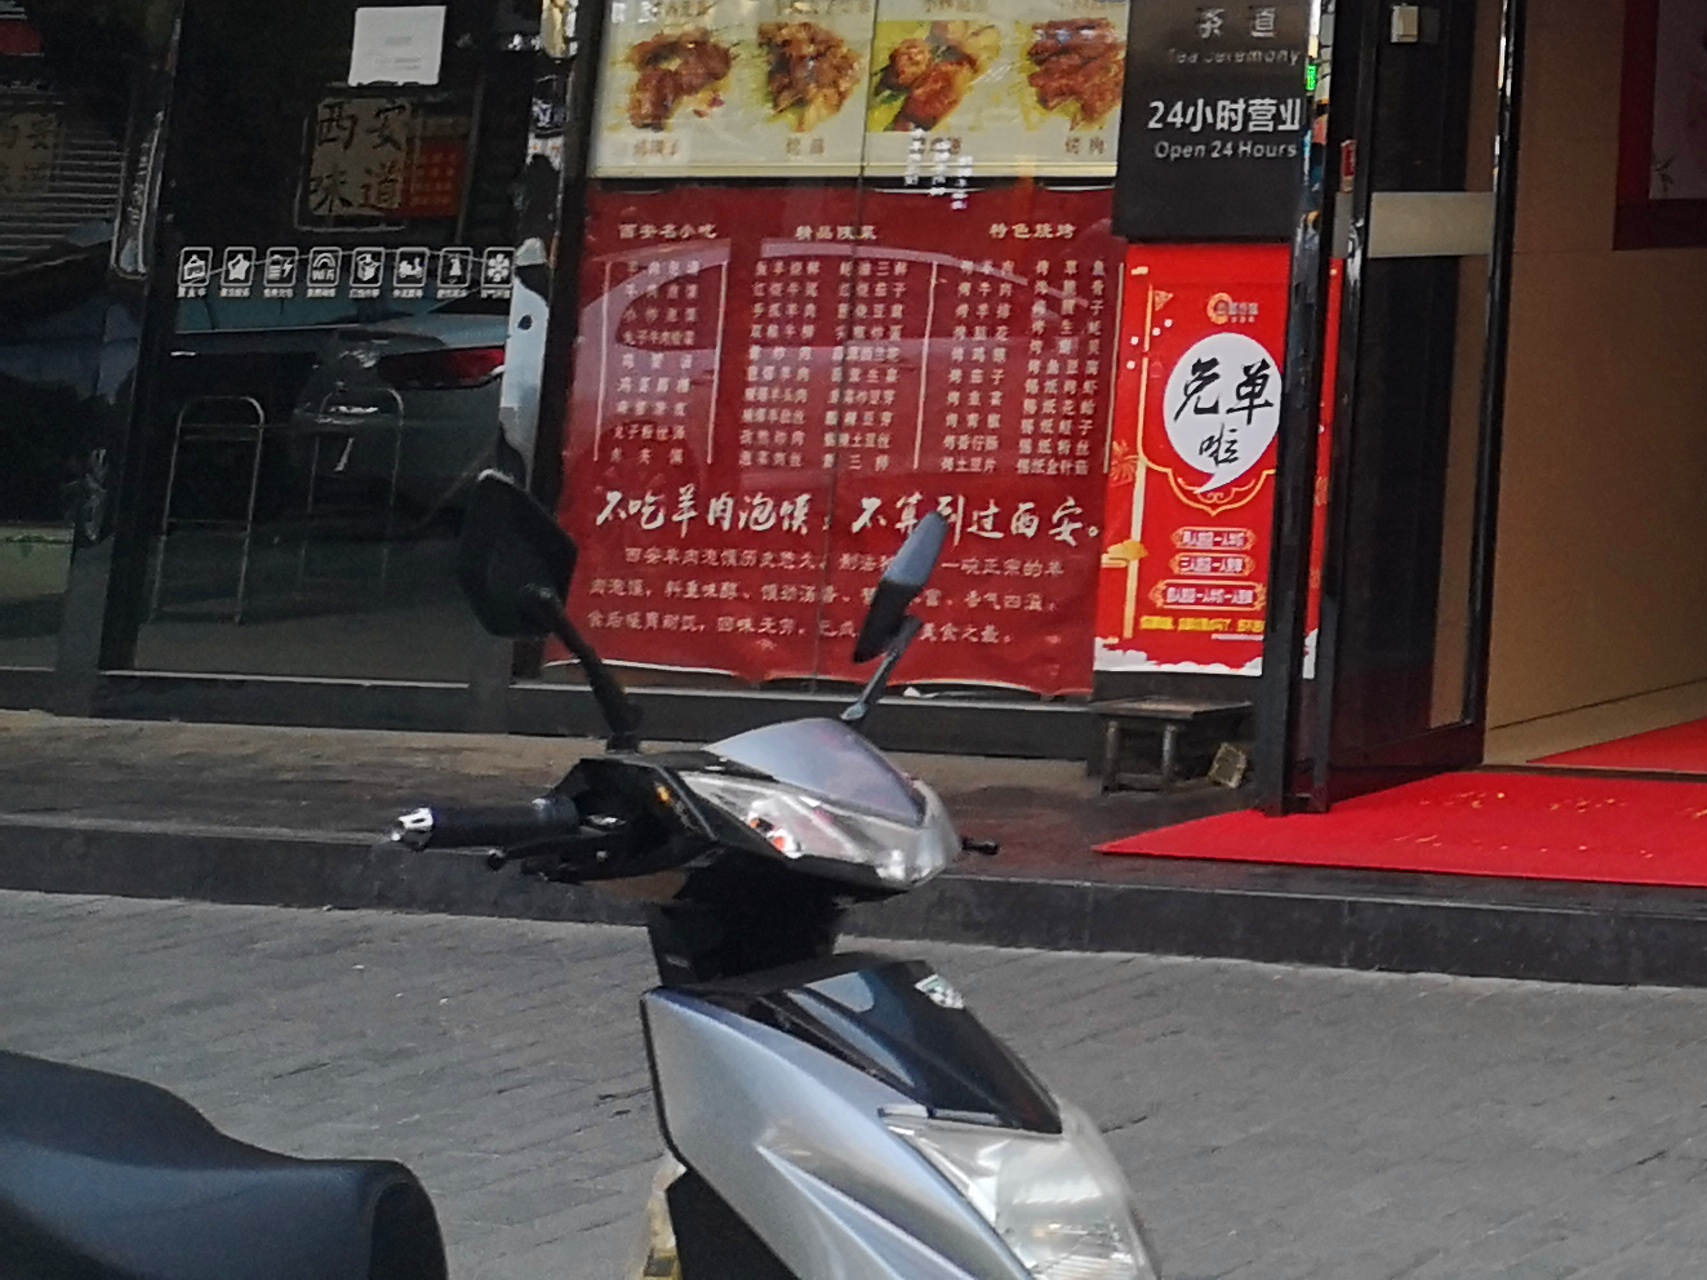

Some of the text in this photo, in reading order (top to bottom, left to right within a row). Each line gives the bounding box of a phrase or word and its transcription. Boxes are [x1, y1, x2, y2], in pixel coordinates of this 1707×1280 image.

[1147, 97, 1301, 133] 24小时营业
[1155, 139, 1298, 162] Open 24 Hours
[1173, 356, 1274, 425] 免单
[1197, 421, 1239, 468] 啦
